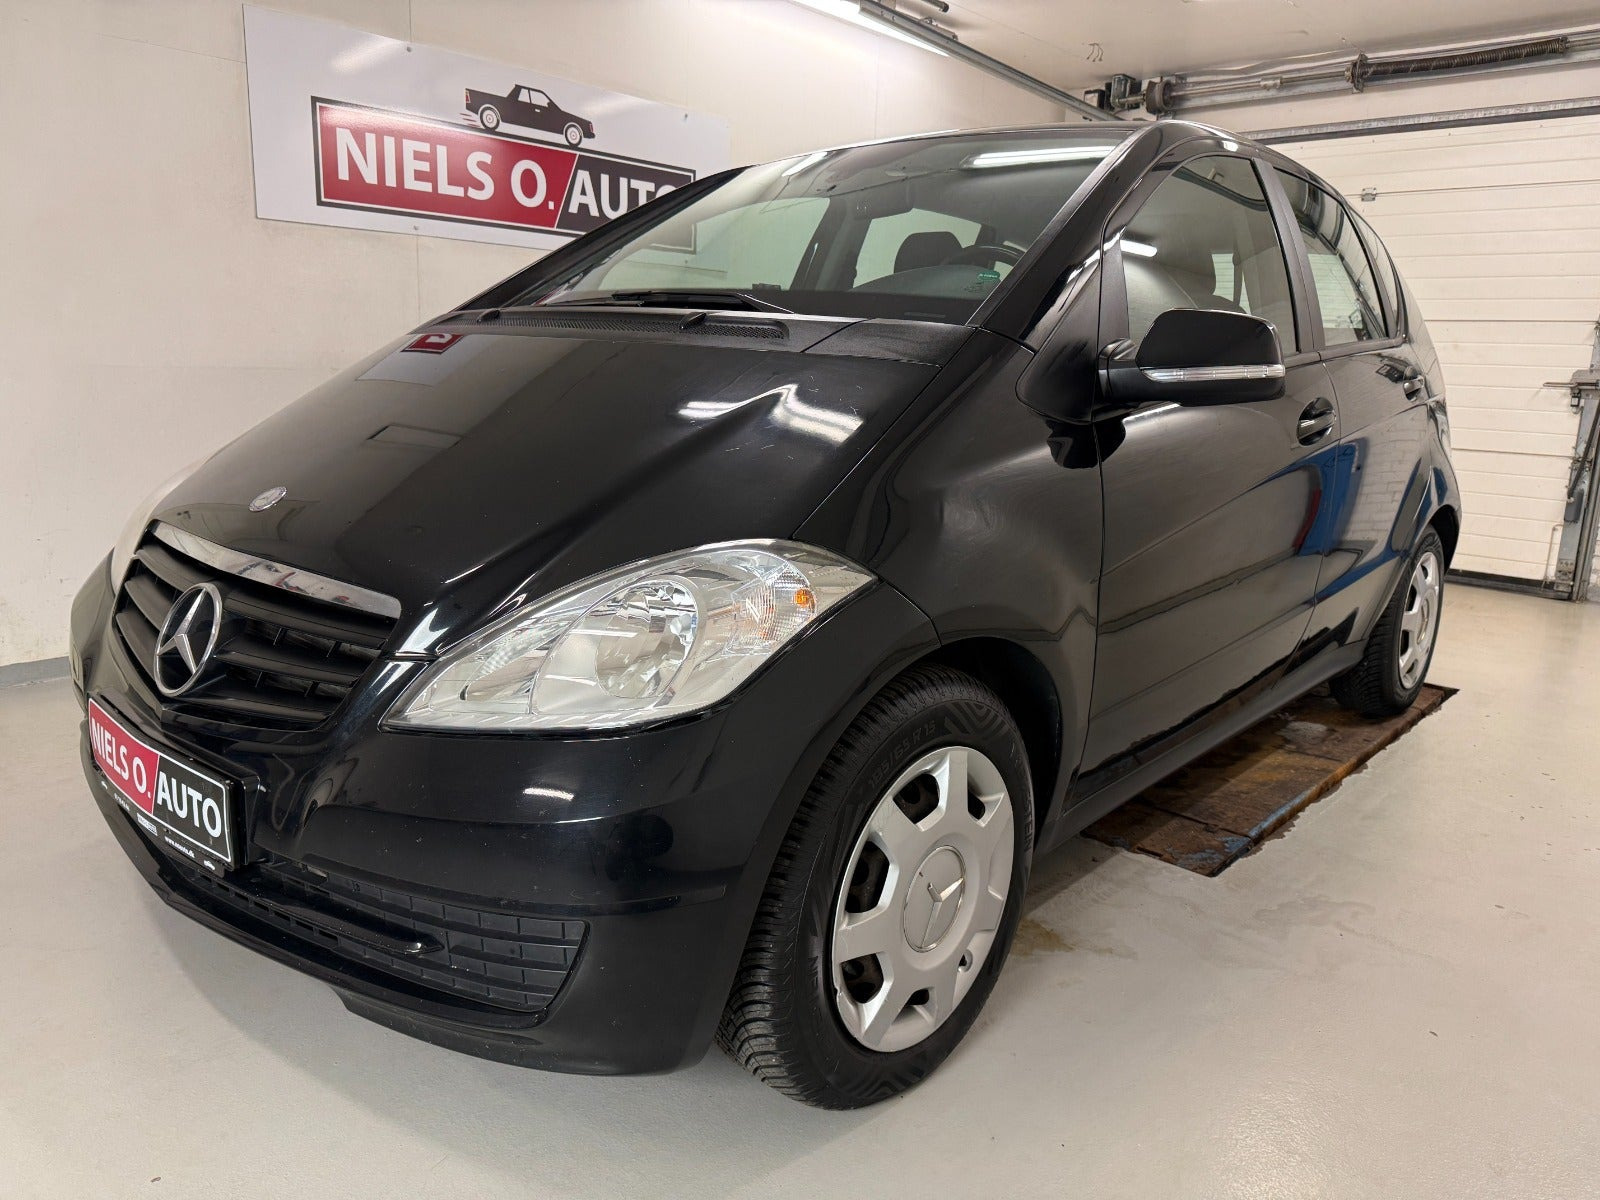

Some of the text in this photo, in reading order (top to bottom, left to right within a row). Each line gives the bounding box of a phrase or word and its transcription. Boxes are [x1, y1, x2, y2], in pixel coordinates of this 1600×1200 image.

[336, 127, 677, 219] NIELS O. AUT
[91, 717, 222, 838] NIELS O. AUTO
